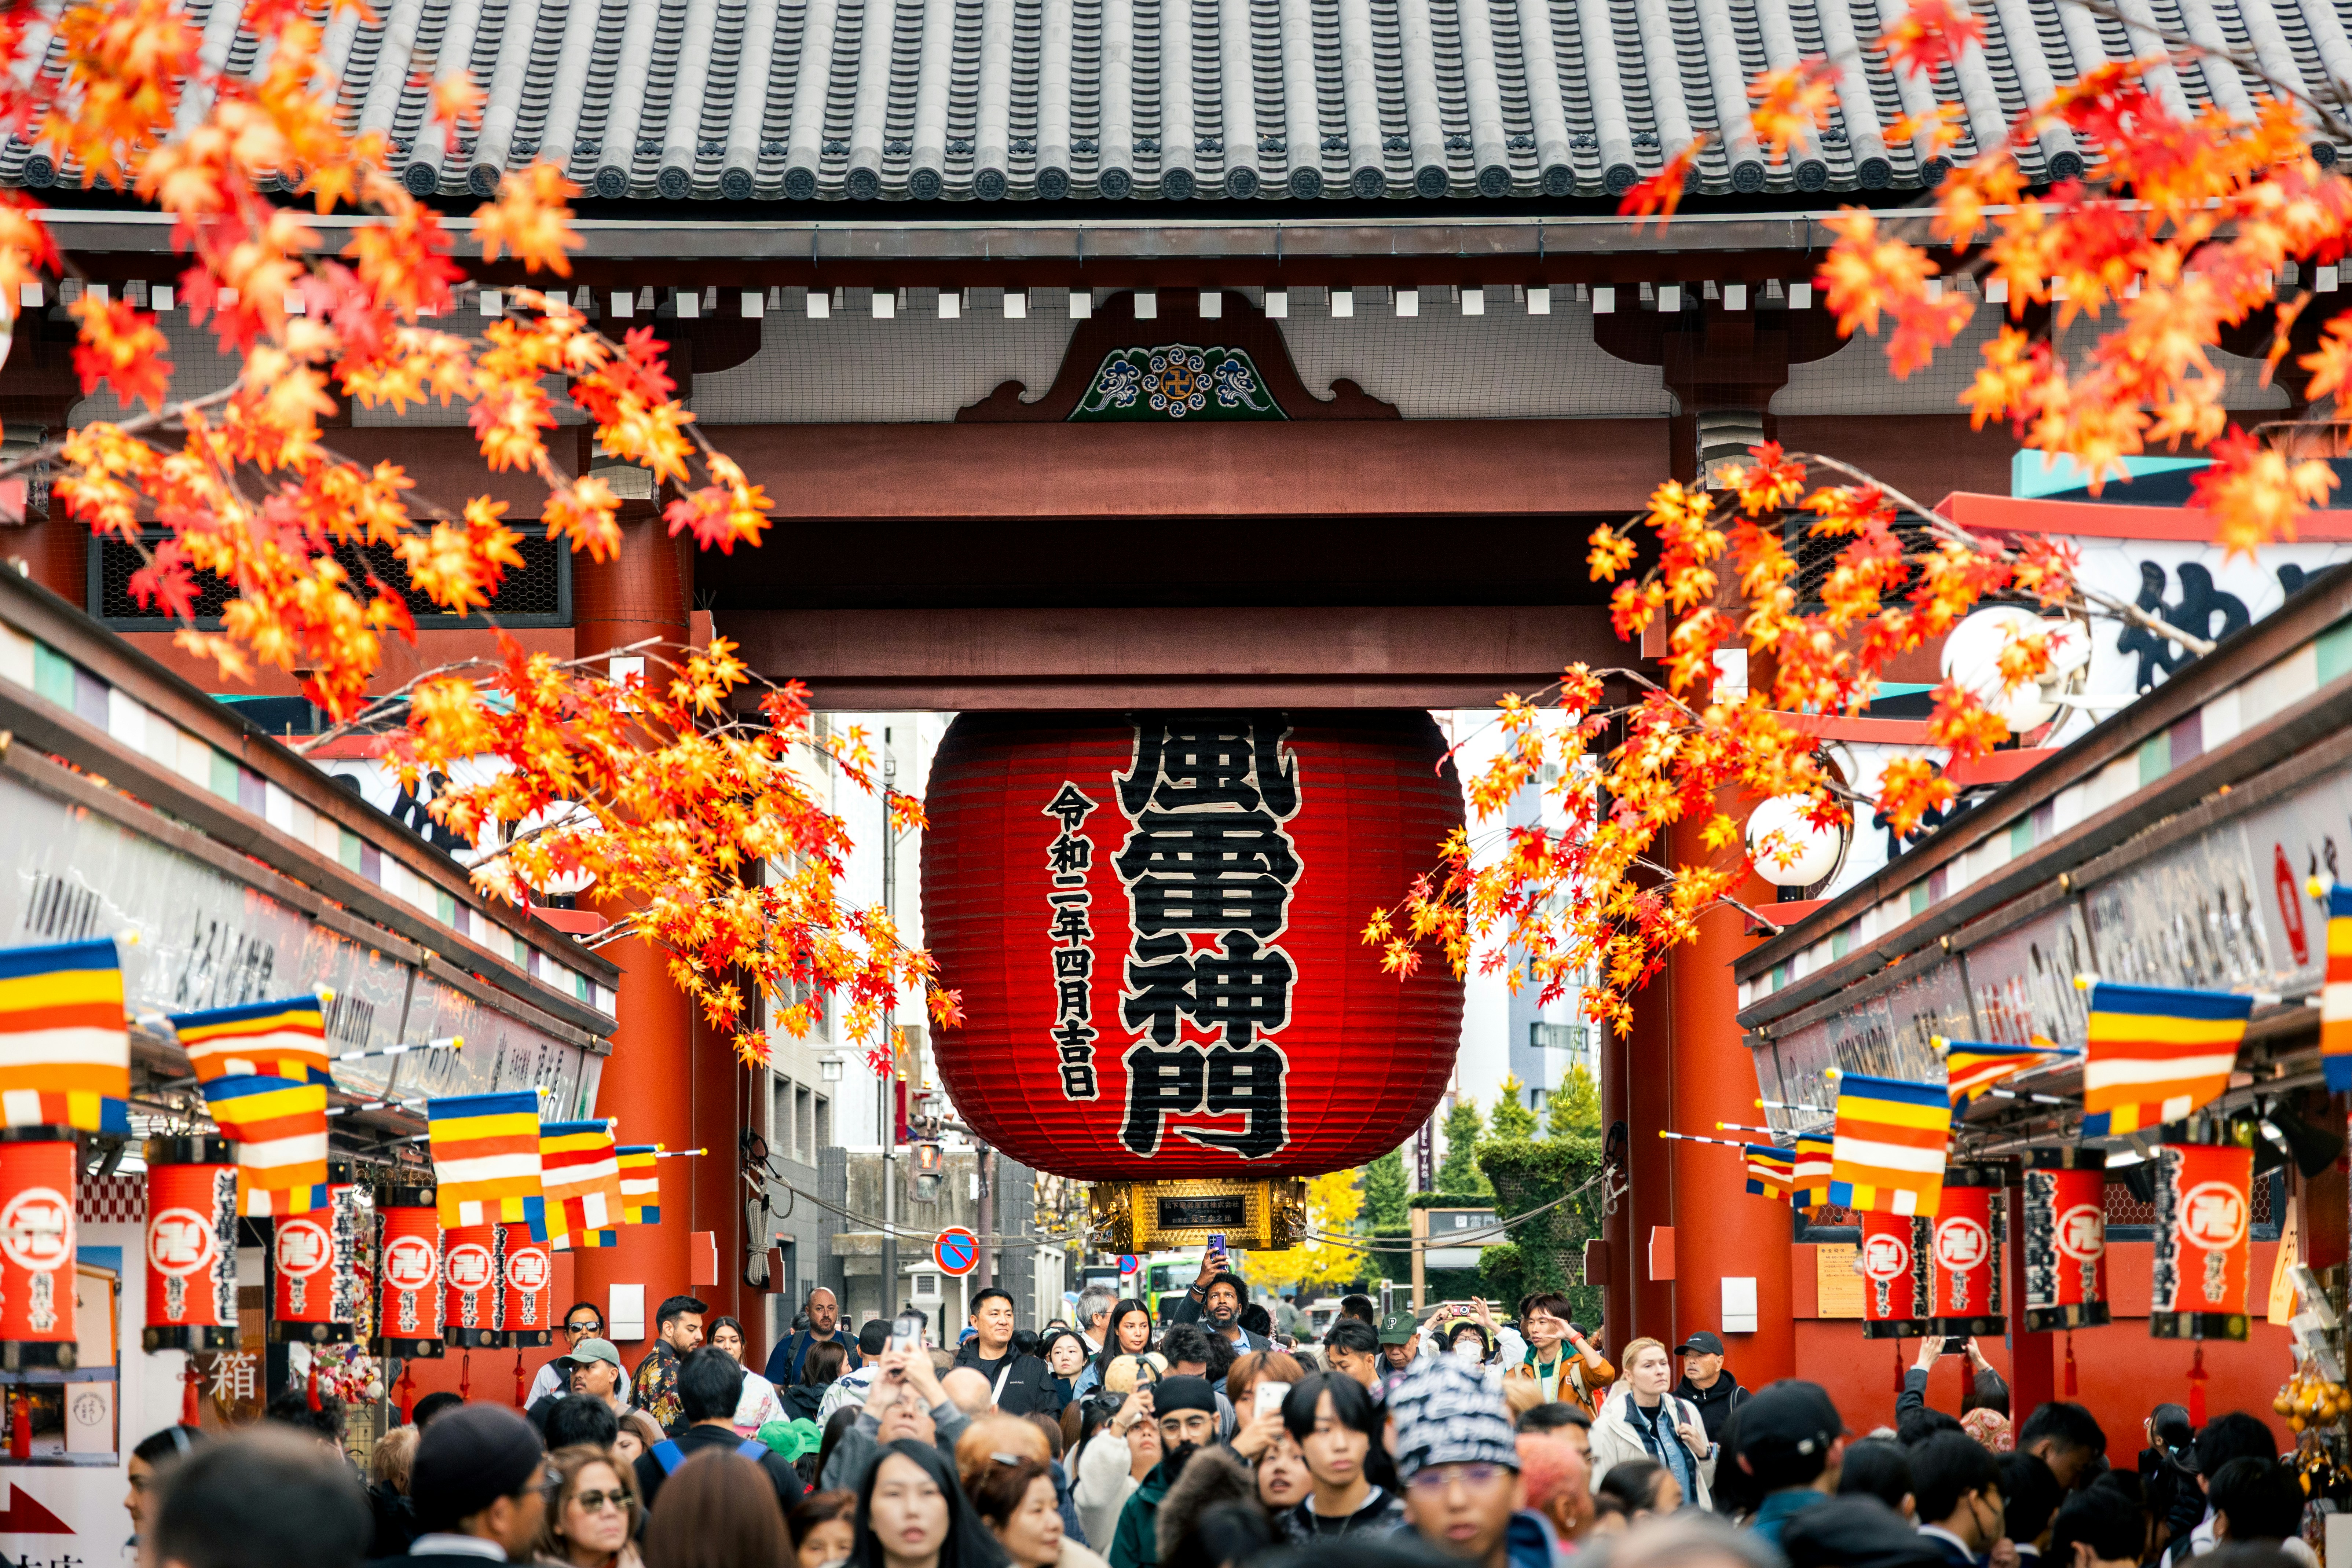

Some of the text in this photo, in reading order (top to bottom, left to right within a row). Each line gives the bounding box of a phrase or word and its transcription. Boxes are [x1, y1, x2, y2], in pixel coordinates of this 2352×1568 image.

[1043, 782, 1098, 1100] 令和二年四月吉日
[1113, 713, 1303, 1157] 風雷神門
[1420, 1149, 1429, 1178] WING
[1470, 1215, 1502, 1228] 雷門
[1388, 1318, 1397, 1329] P
[209, 1352, 257, 1400] 箱
